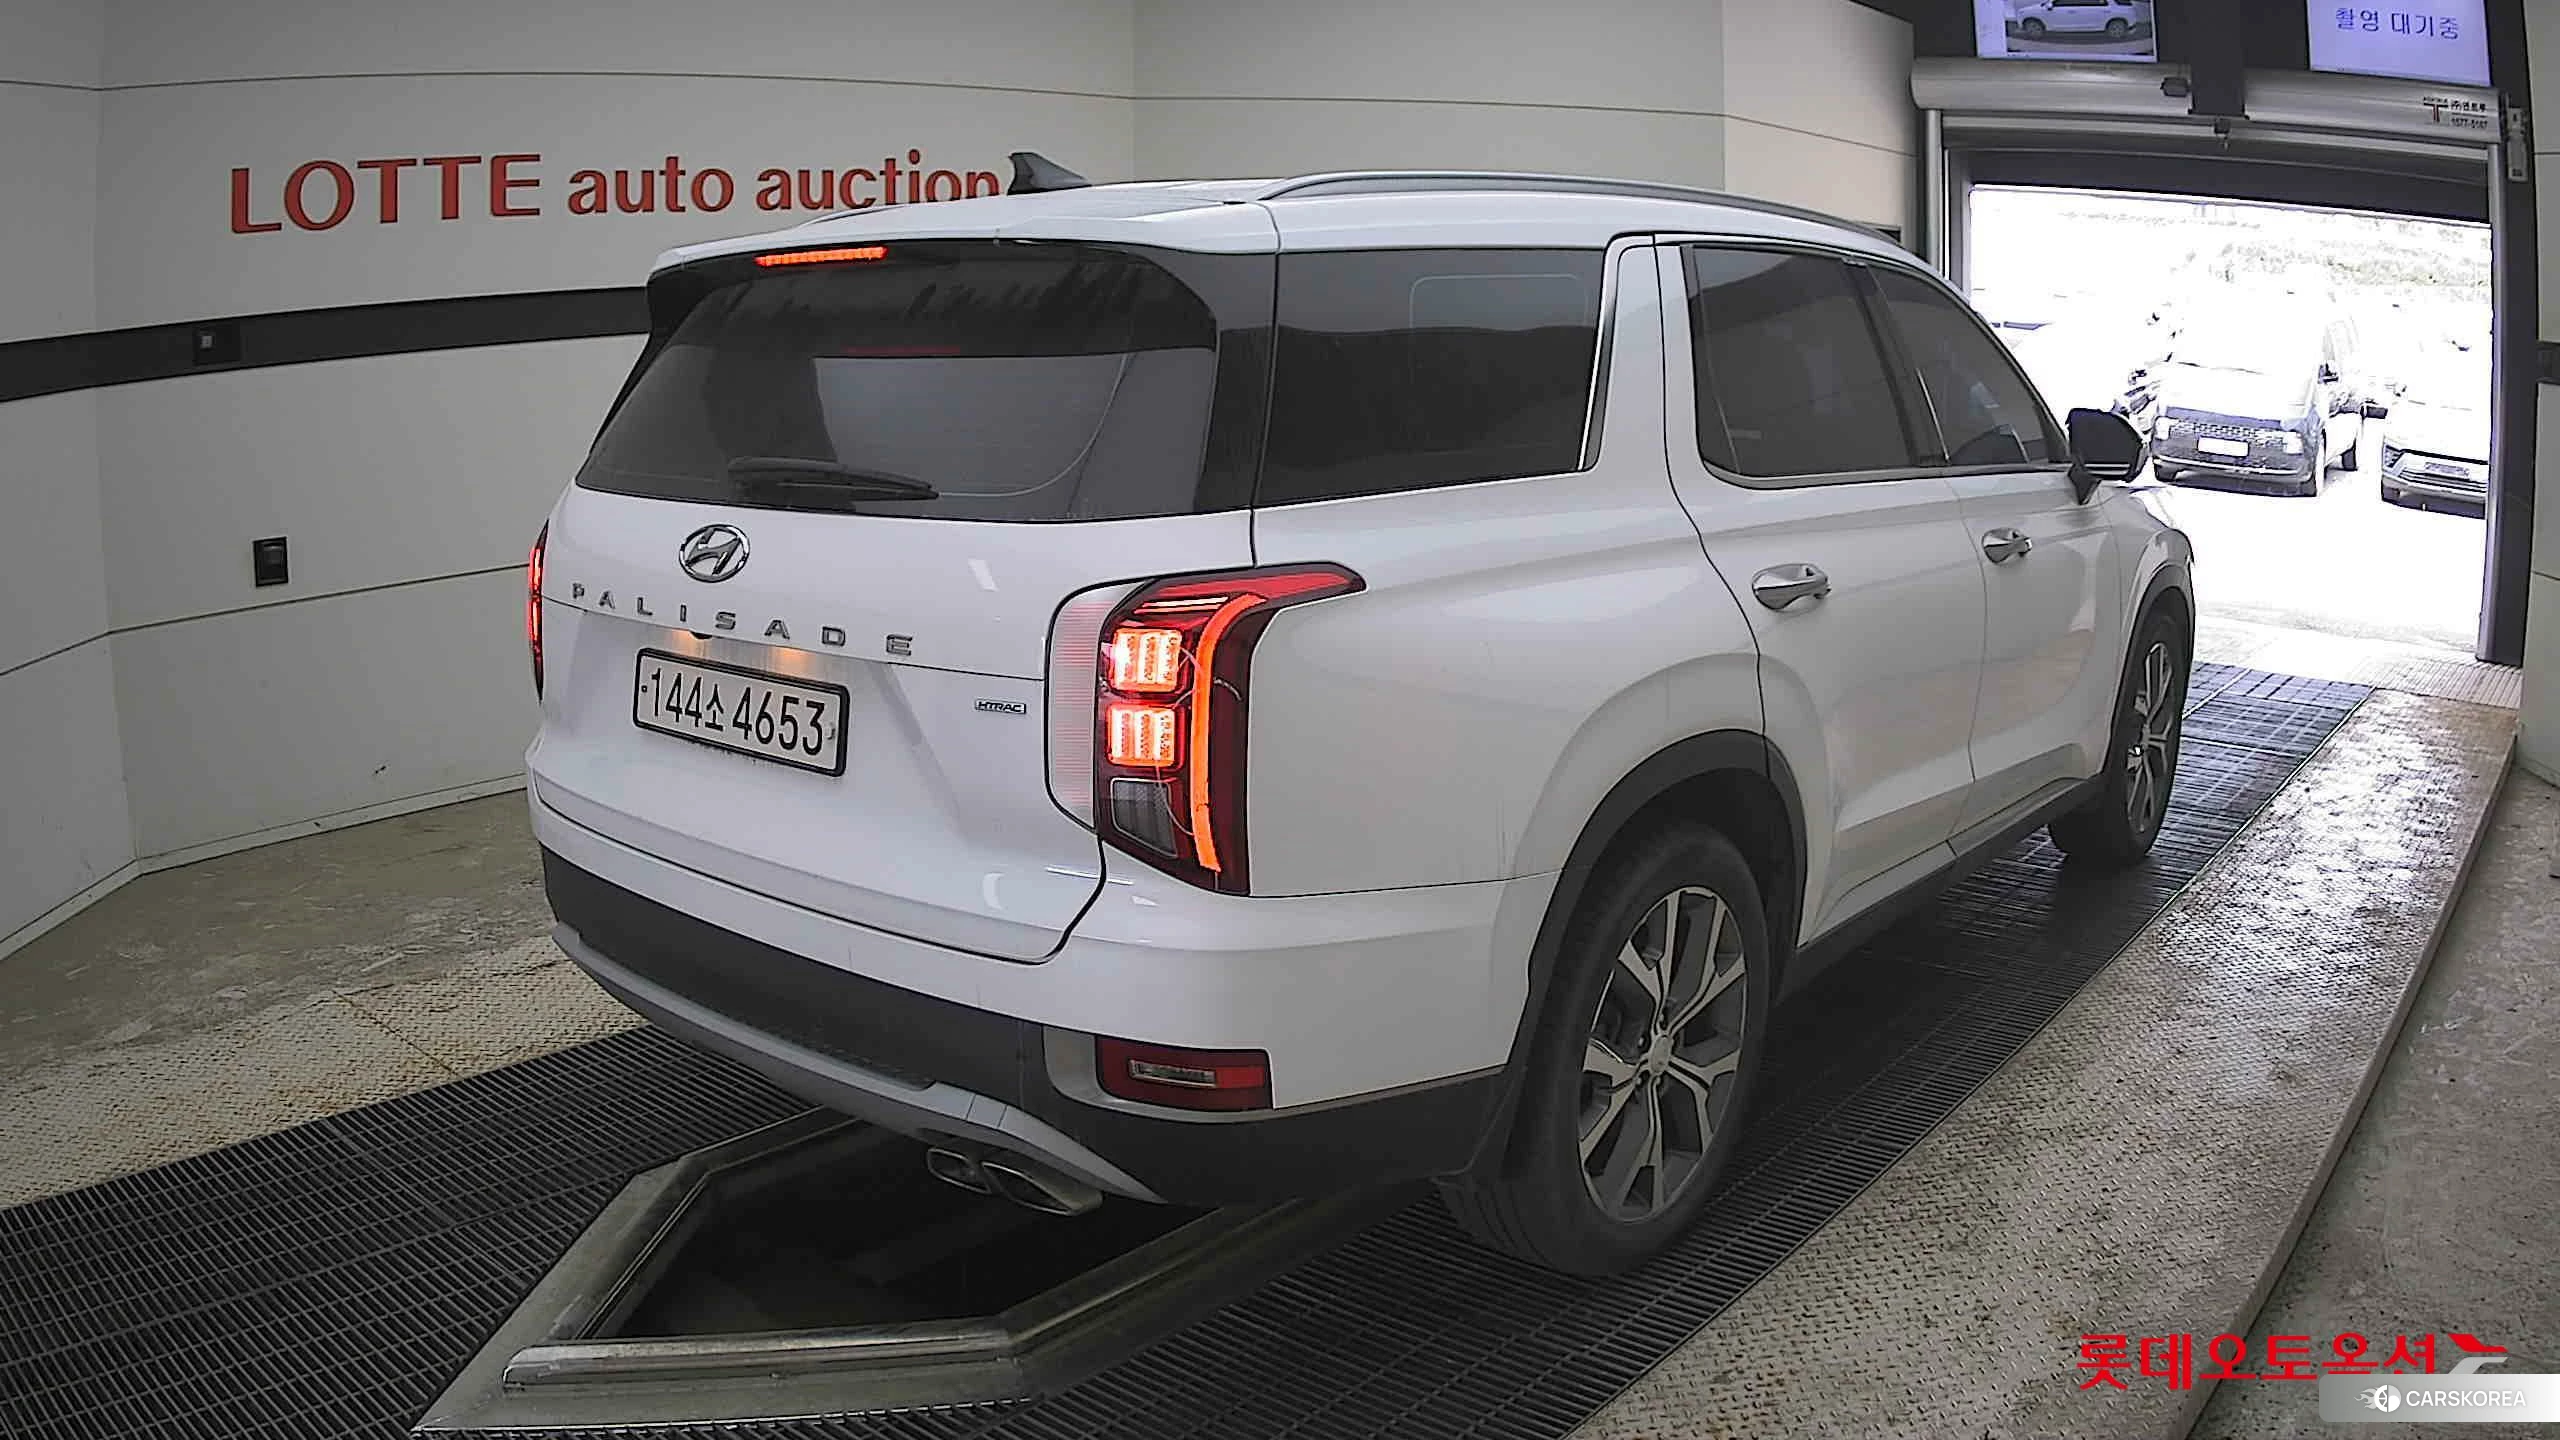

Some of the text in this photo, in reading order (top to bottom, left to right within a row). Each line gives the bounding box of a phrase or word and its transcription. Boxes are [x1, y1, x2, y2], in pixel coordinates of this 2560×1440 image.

[2391, 13, 2459, 40] 대기중
[231, 148, 999, 233] LOTTE auto auction
[572, 582, 914, 657] PALISADE
[651, 667, 825, 755] 144소 4653
[977, 700, 1023, 713] HTRAC
